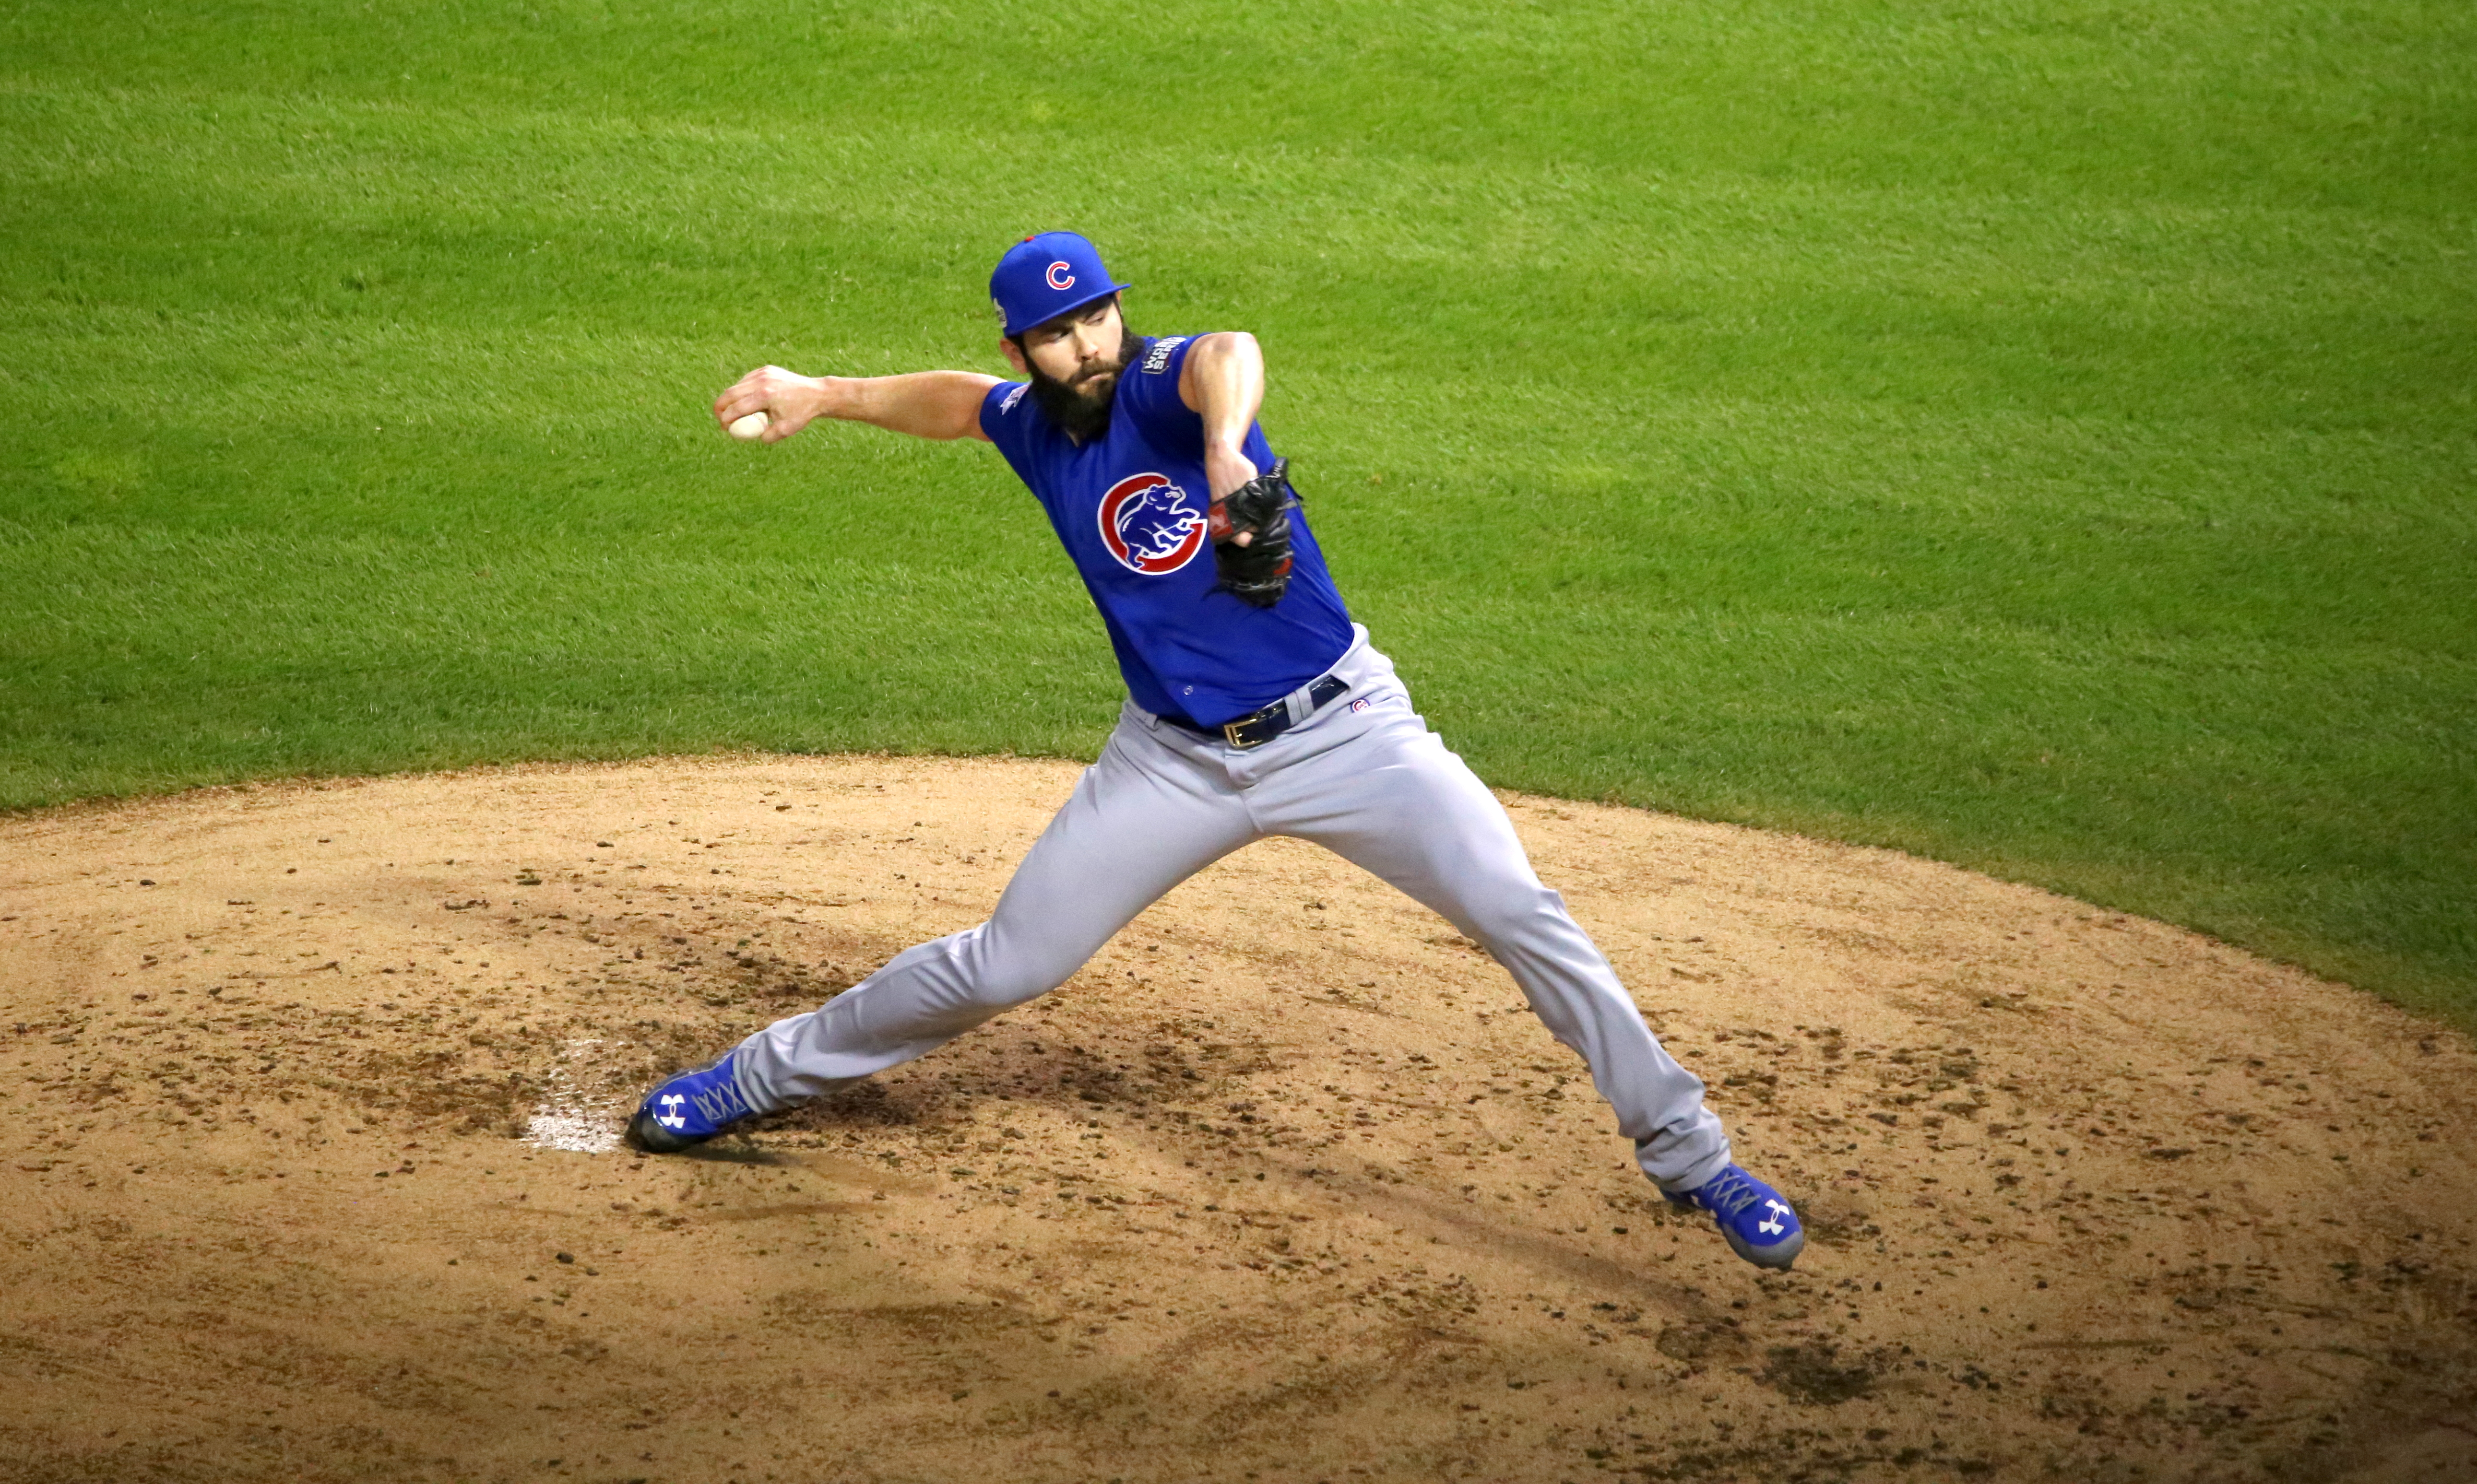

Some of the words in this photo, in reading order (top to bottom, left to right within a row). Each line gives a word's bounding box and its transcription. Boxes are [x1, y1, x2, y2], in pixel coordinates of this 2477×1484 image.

[1046, 261, 1075, 290] C
[1144, 338, 1173, 369] WOR
[1153, 338, 1186, 369] SERI
